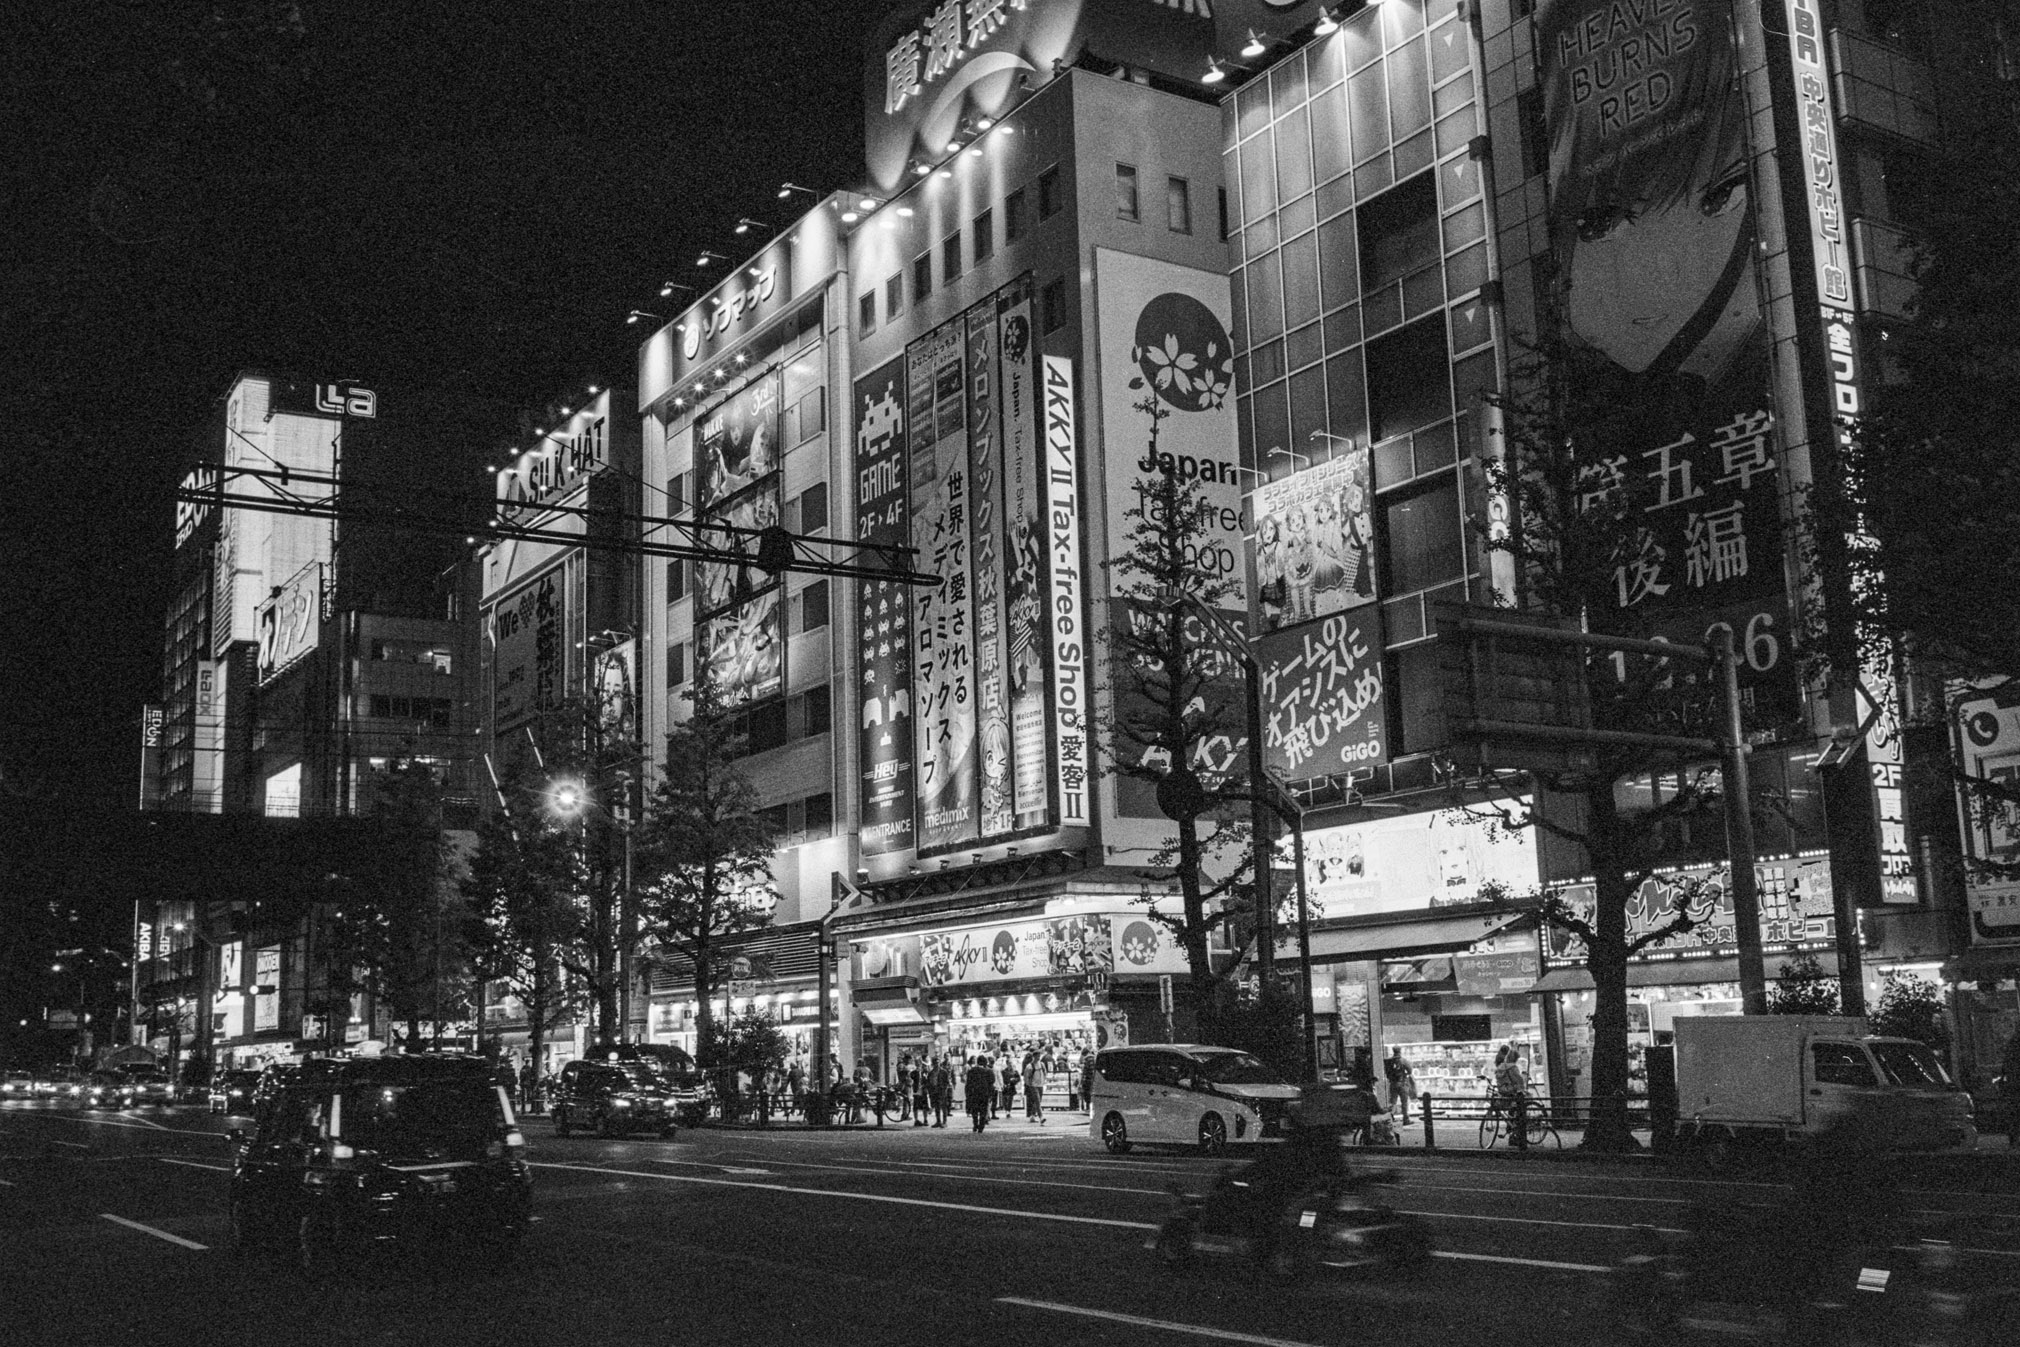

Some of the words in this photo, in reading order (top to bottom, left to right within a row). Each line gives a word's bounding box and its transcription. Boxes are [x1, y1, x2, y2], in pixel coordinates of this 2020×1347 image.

[1560, 0, 1684, 67] HEAVE
[1572, 9, 1696, 105] BURNS
[1600, 72, 1671, 138] RED
[703, 264, 776, 340] ソフマップ
[1046, 361, 1074, 465] AKKY
[529, 444, 566, 503] SILK
[571, 415, 605, 481] HAT
[859, 452, 902, 506] GAME
[858, 513, 876, 541] 2F
[886, 501, 902, 527] 4F
[1608, 500, 1749, 608] 後編
[947, 470, 968, 704] 世界で愛される
[1051, 495, 1079, 634] Tax-free
[917, 594, 938, 785] アロマソープ
[1056, 642, 1083, 727] Shop
[1262, 615, 1348, 704] ゲームの
[873, 761, 899, 782] Hey
[1341, 740, 1381, 763] GiGO
[1871, 762, 1902, 787] 2F
[924, 804, 971, 830] medimix
[137, 922, 152, 962] AKIBA
